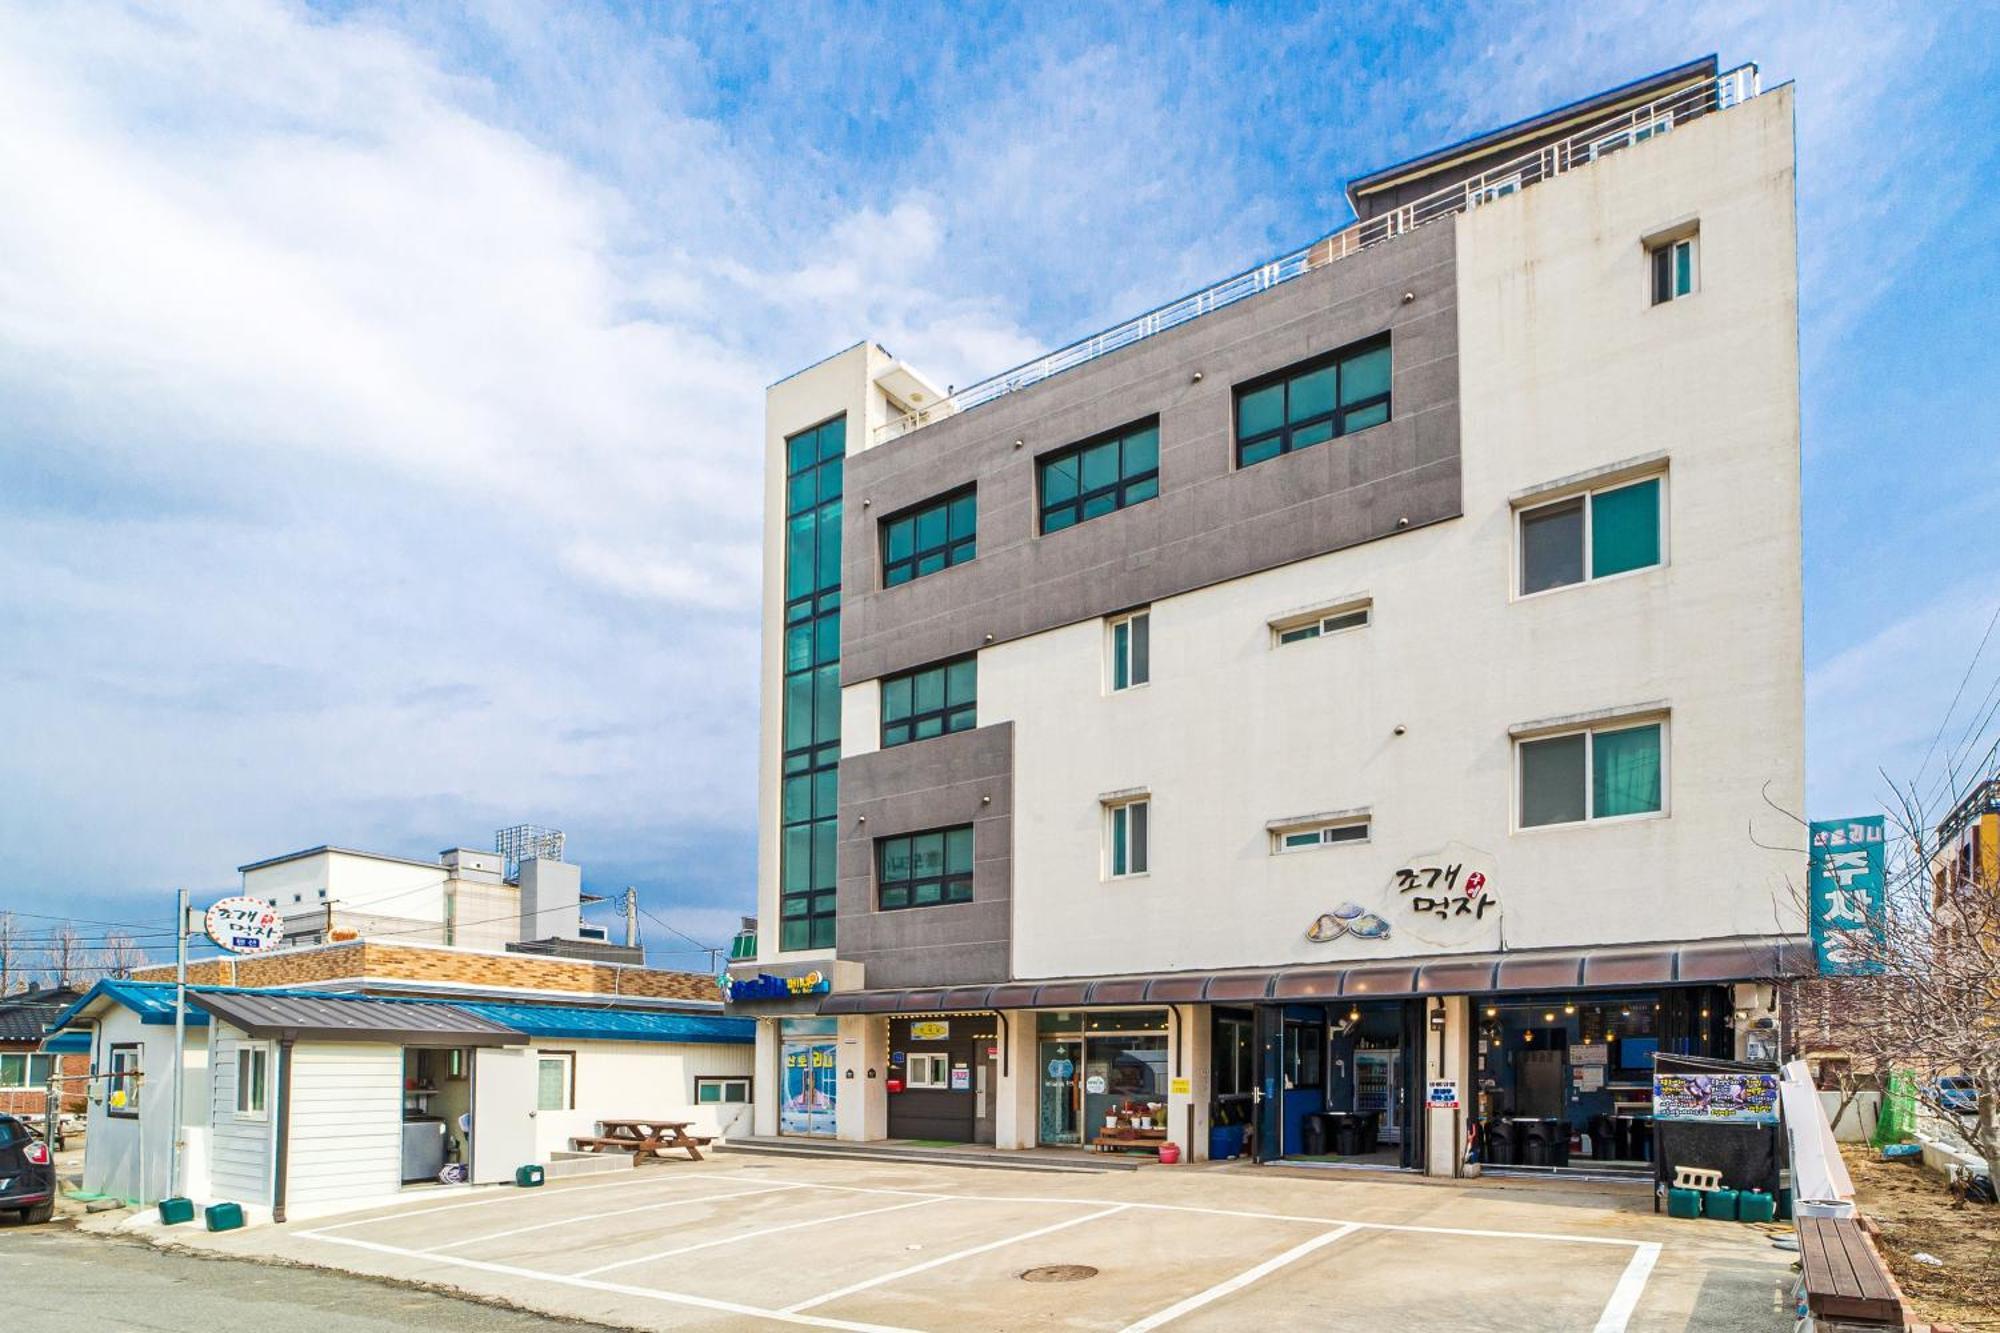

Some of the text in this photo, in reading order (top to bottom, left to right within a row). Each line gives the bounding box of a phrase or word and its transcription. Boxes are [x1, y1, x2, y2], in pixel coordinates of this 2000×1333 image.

[1814, 823, 1883, 846] 산토리니
[1396, 863, 1462, 893] 조개
[1412, 893, 1496, 920] 먹자
